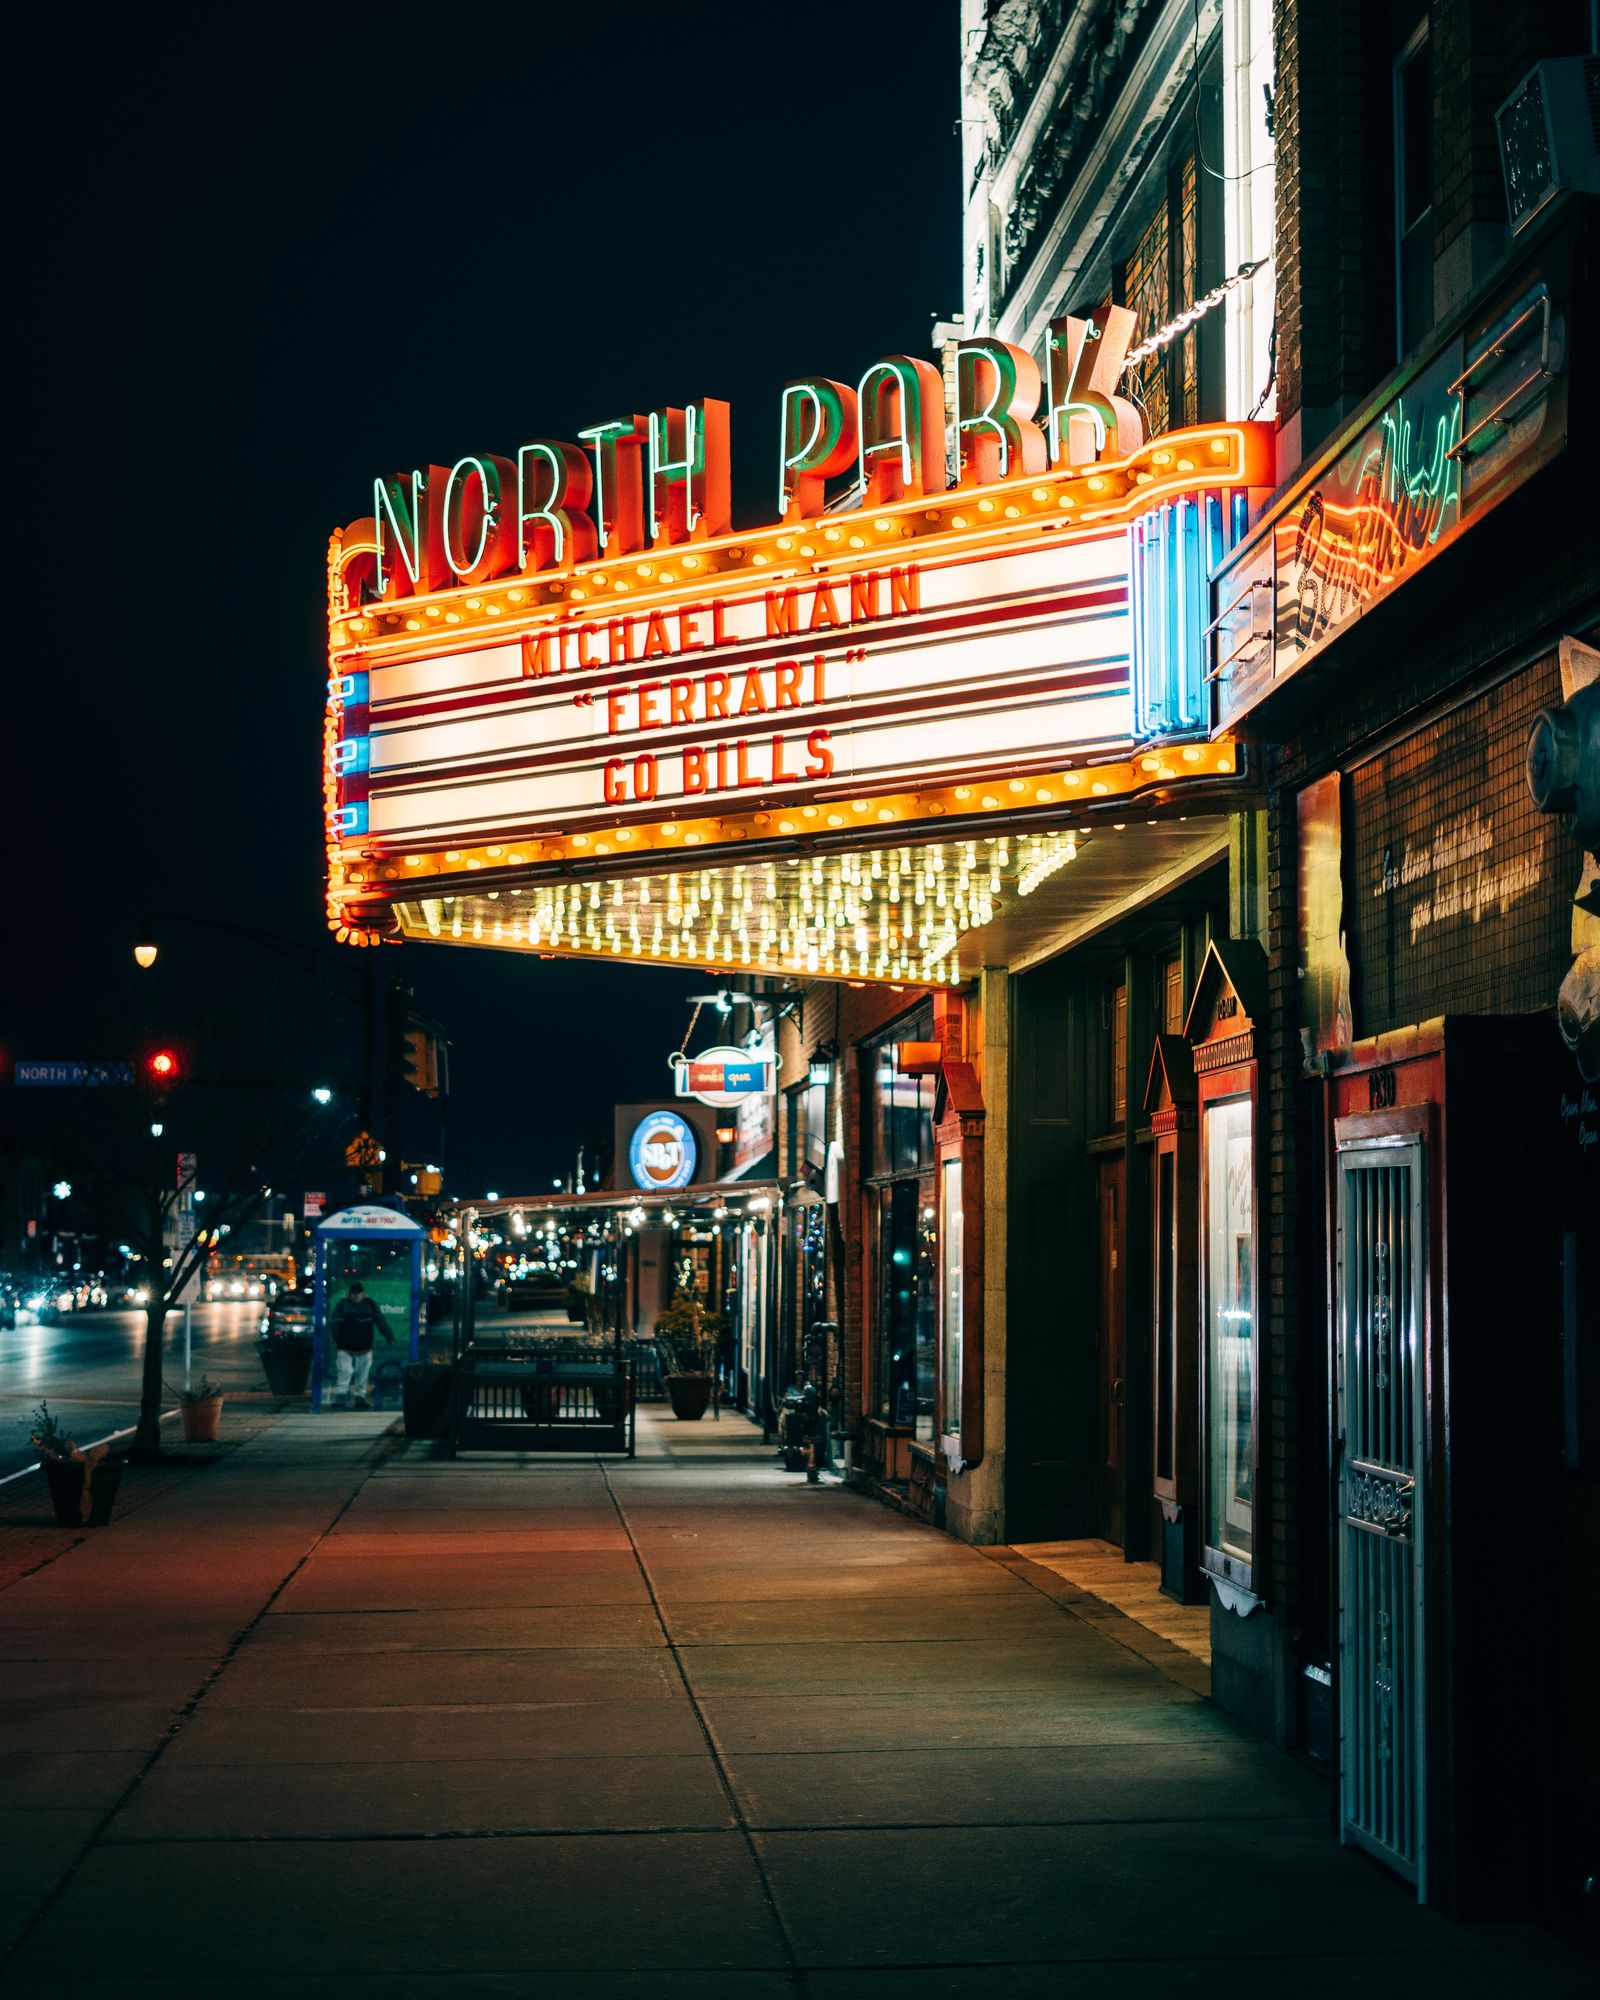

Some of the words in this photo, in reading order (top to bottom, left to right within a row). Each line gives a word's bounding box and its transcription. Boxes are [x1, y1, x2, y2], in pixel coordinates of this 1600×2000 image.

[373, 397, 732, 600] NORTH
[778, 304, 1143, 516] PARK
[520, 599, 739, 680] MICHAEL
[764, 563, 921, 640] MANN
[603, 752, 659, 805] GO
[682, 728, 835, 797] BILLS
[20, 1066, 67, 1081] NORTH
[72, 1066, 109, 1081] PK
